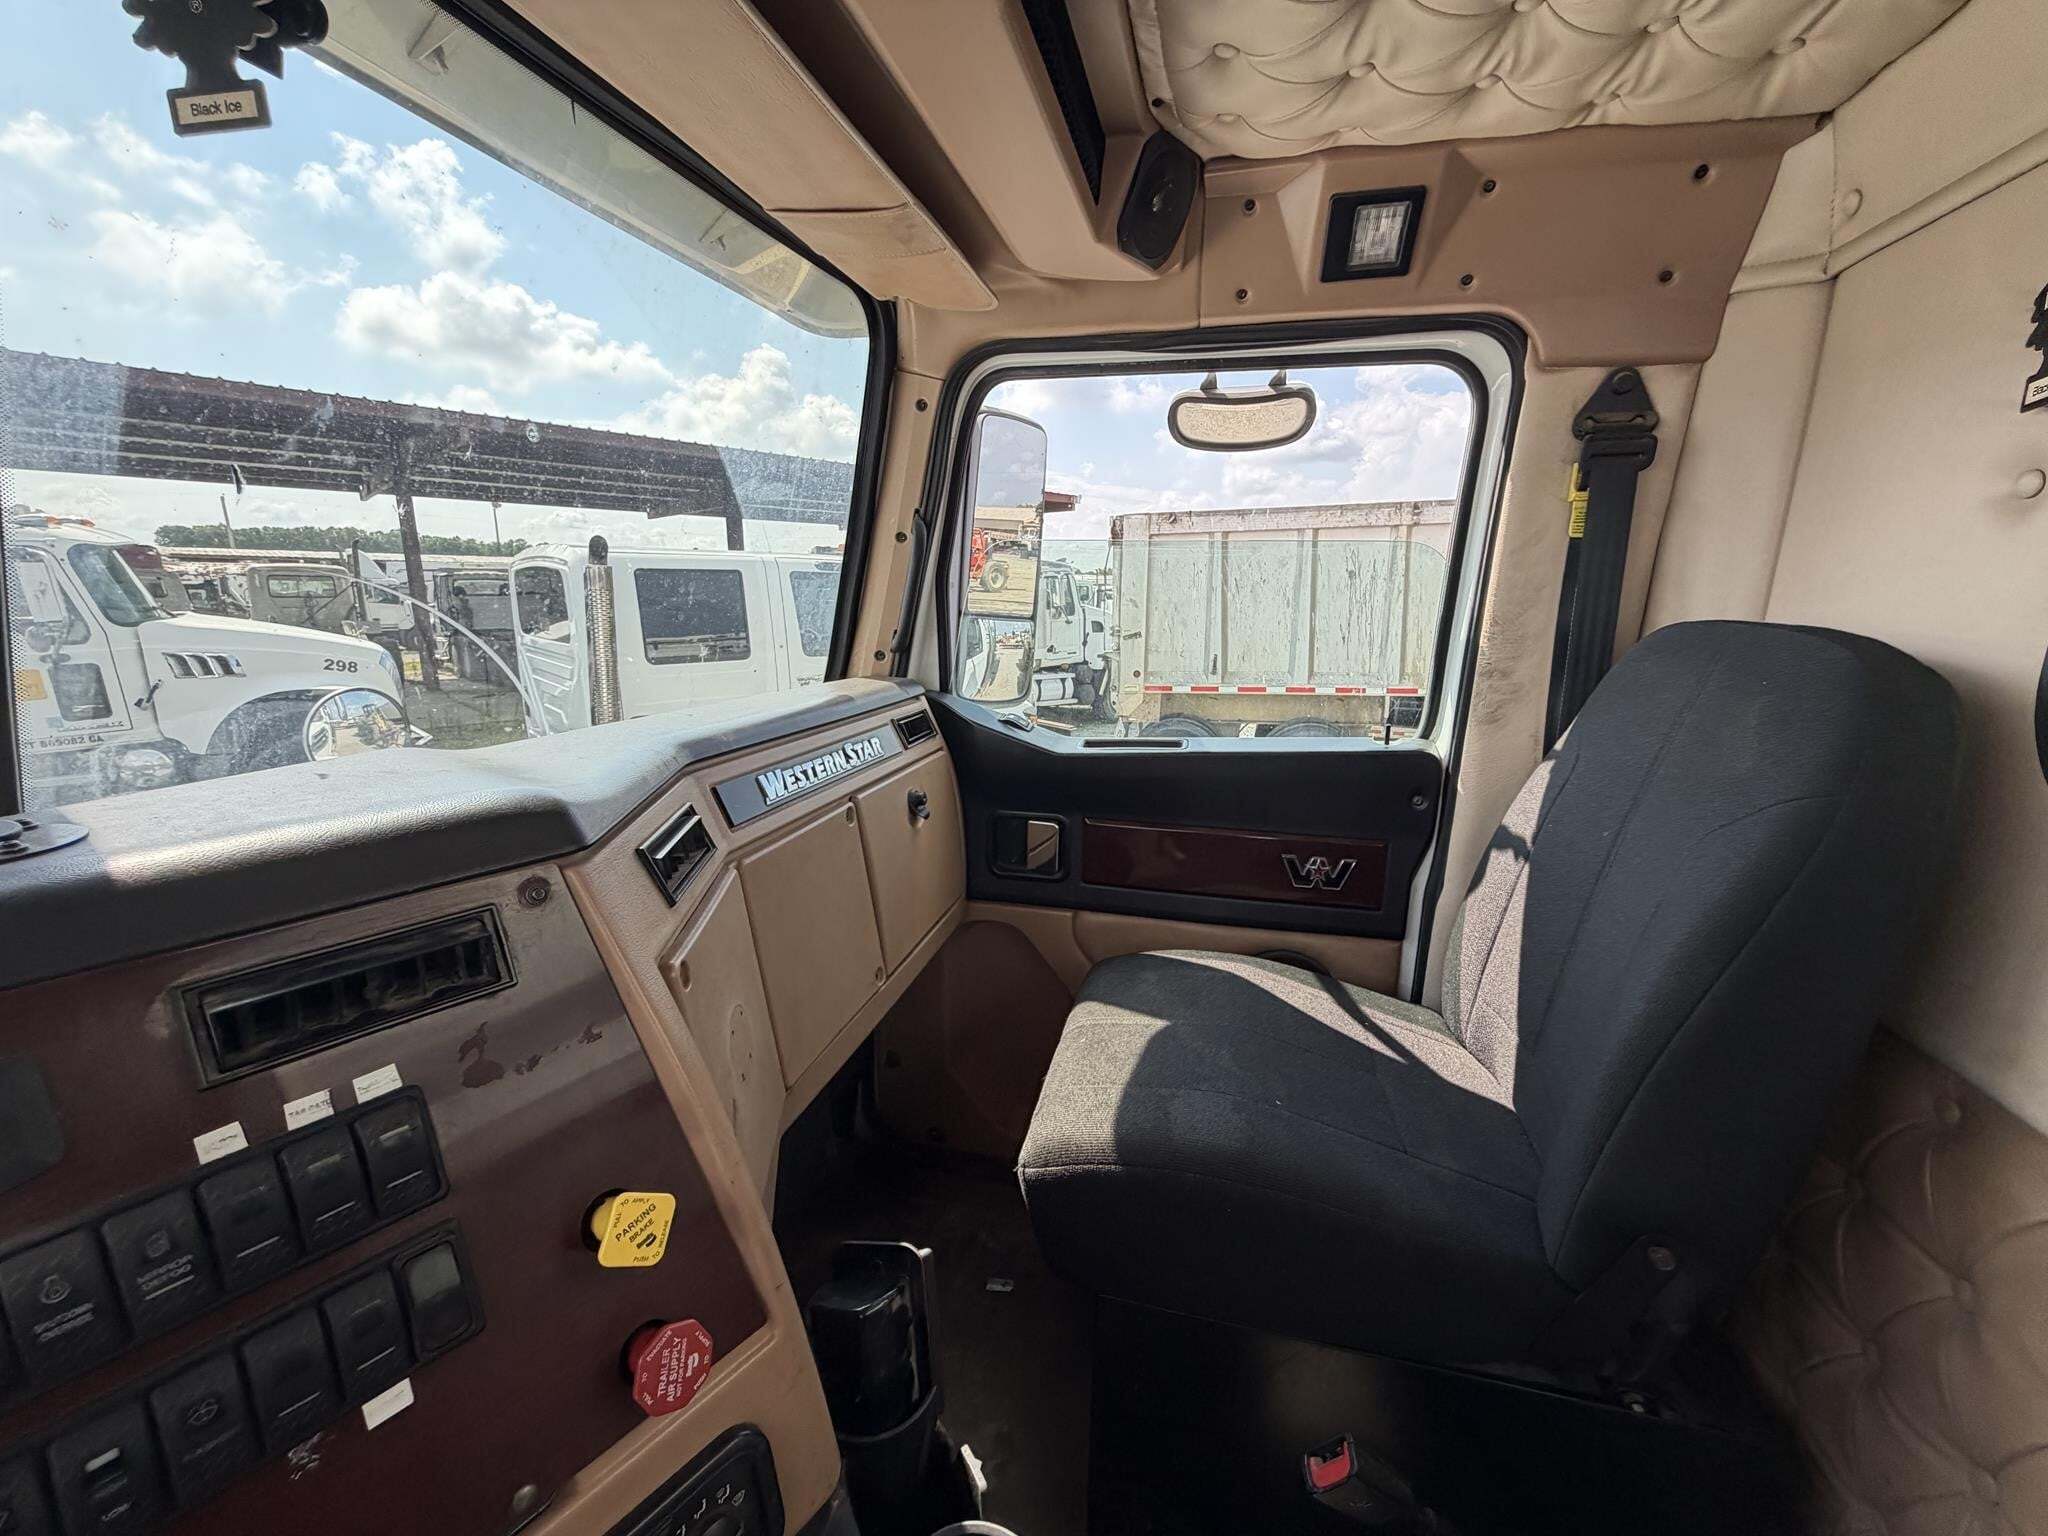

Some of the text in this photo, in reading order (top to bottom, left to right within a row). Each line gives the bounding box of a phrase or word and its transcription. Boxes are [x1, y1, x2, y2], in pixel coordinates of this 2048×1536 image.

[191, 99, 243, 117] Black Ice
[323, 658, 358, 673] 298
[615, 1203, 656, 1242] PARKING
[628, 1217, 655, 1243] BRAKE
[657, 1347, 671, 1398] TRAILER
[666, 1337, 681, 1402] AIR SUPPLY
